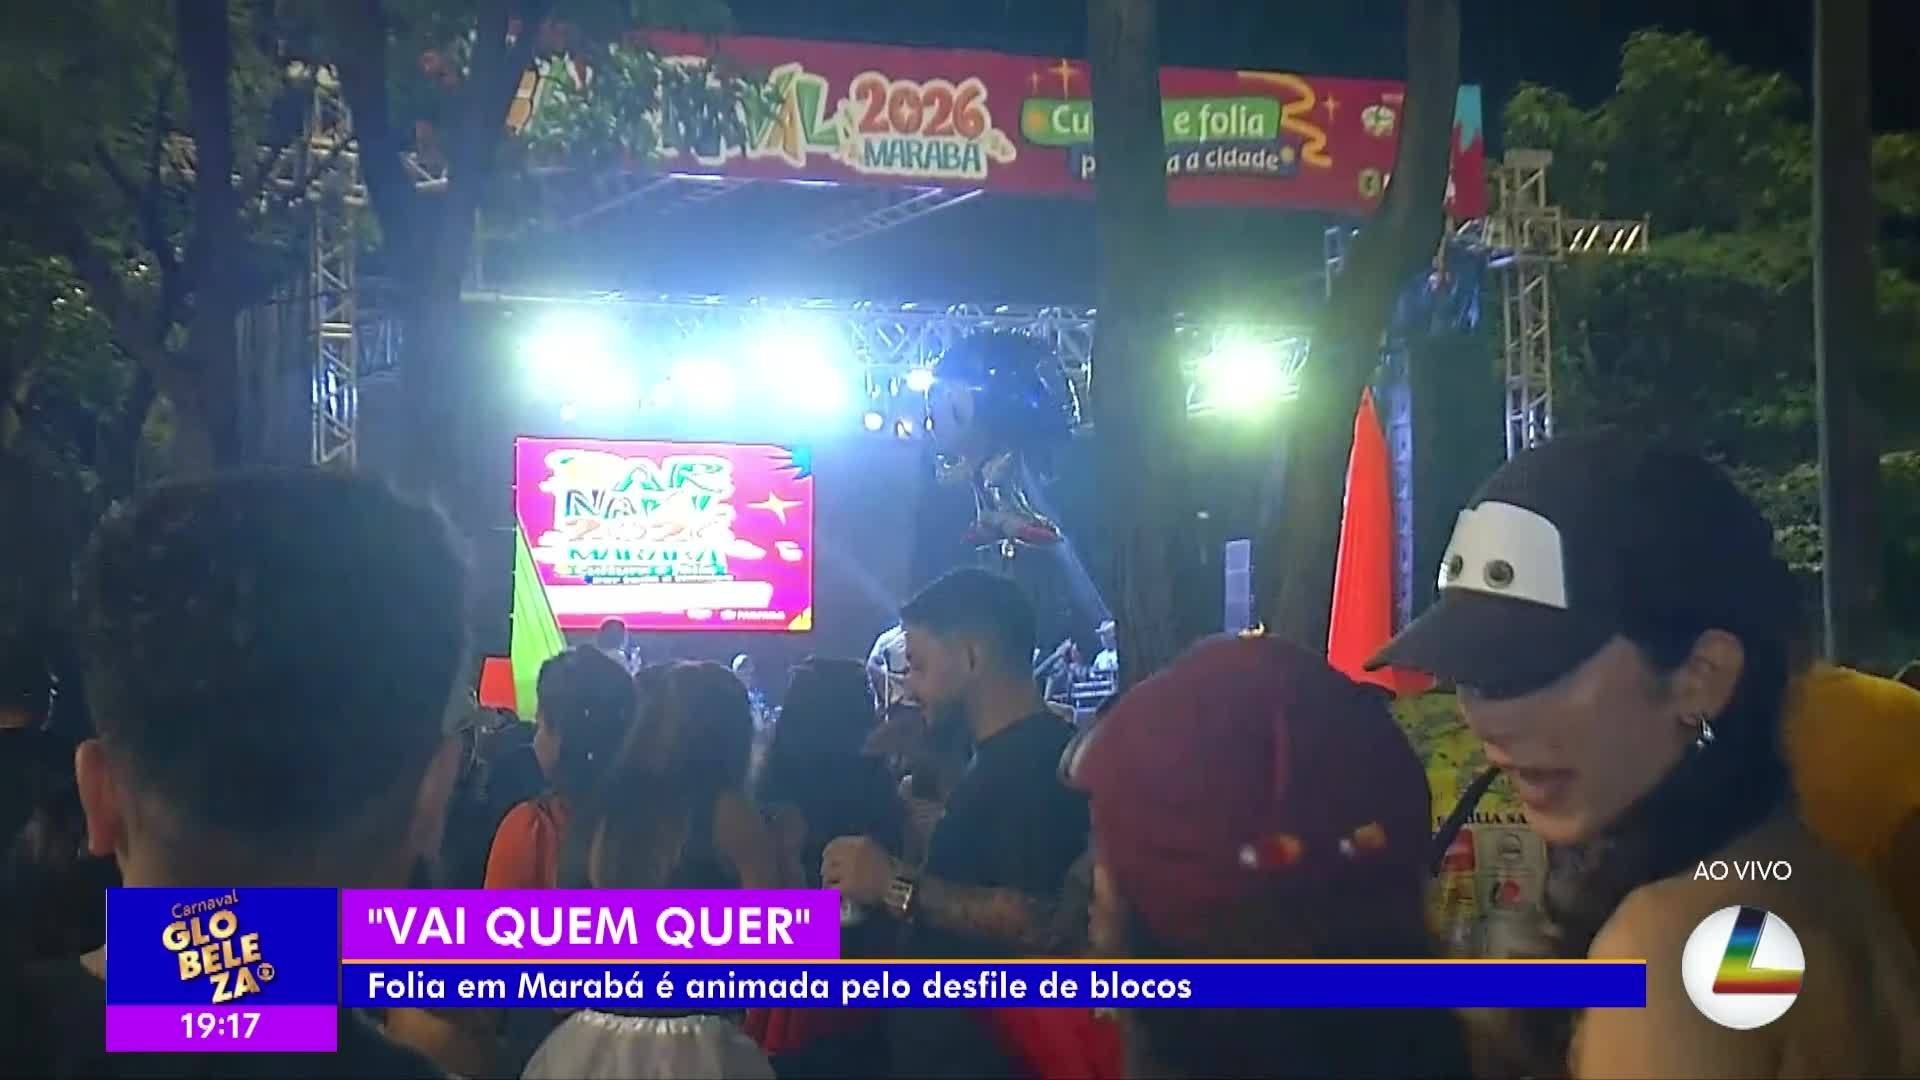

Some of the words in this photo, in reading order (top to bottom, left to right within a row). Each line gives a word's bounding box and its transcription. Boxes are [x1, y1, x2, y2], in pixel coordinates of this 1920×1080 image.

[854, 73, 986, 139] 2026
[1173, 111, 1190, 135] e
[1199, 103, 1264, 142] folia
[1205, 147, 1279, 171] cidade
